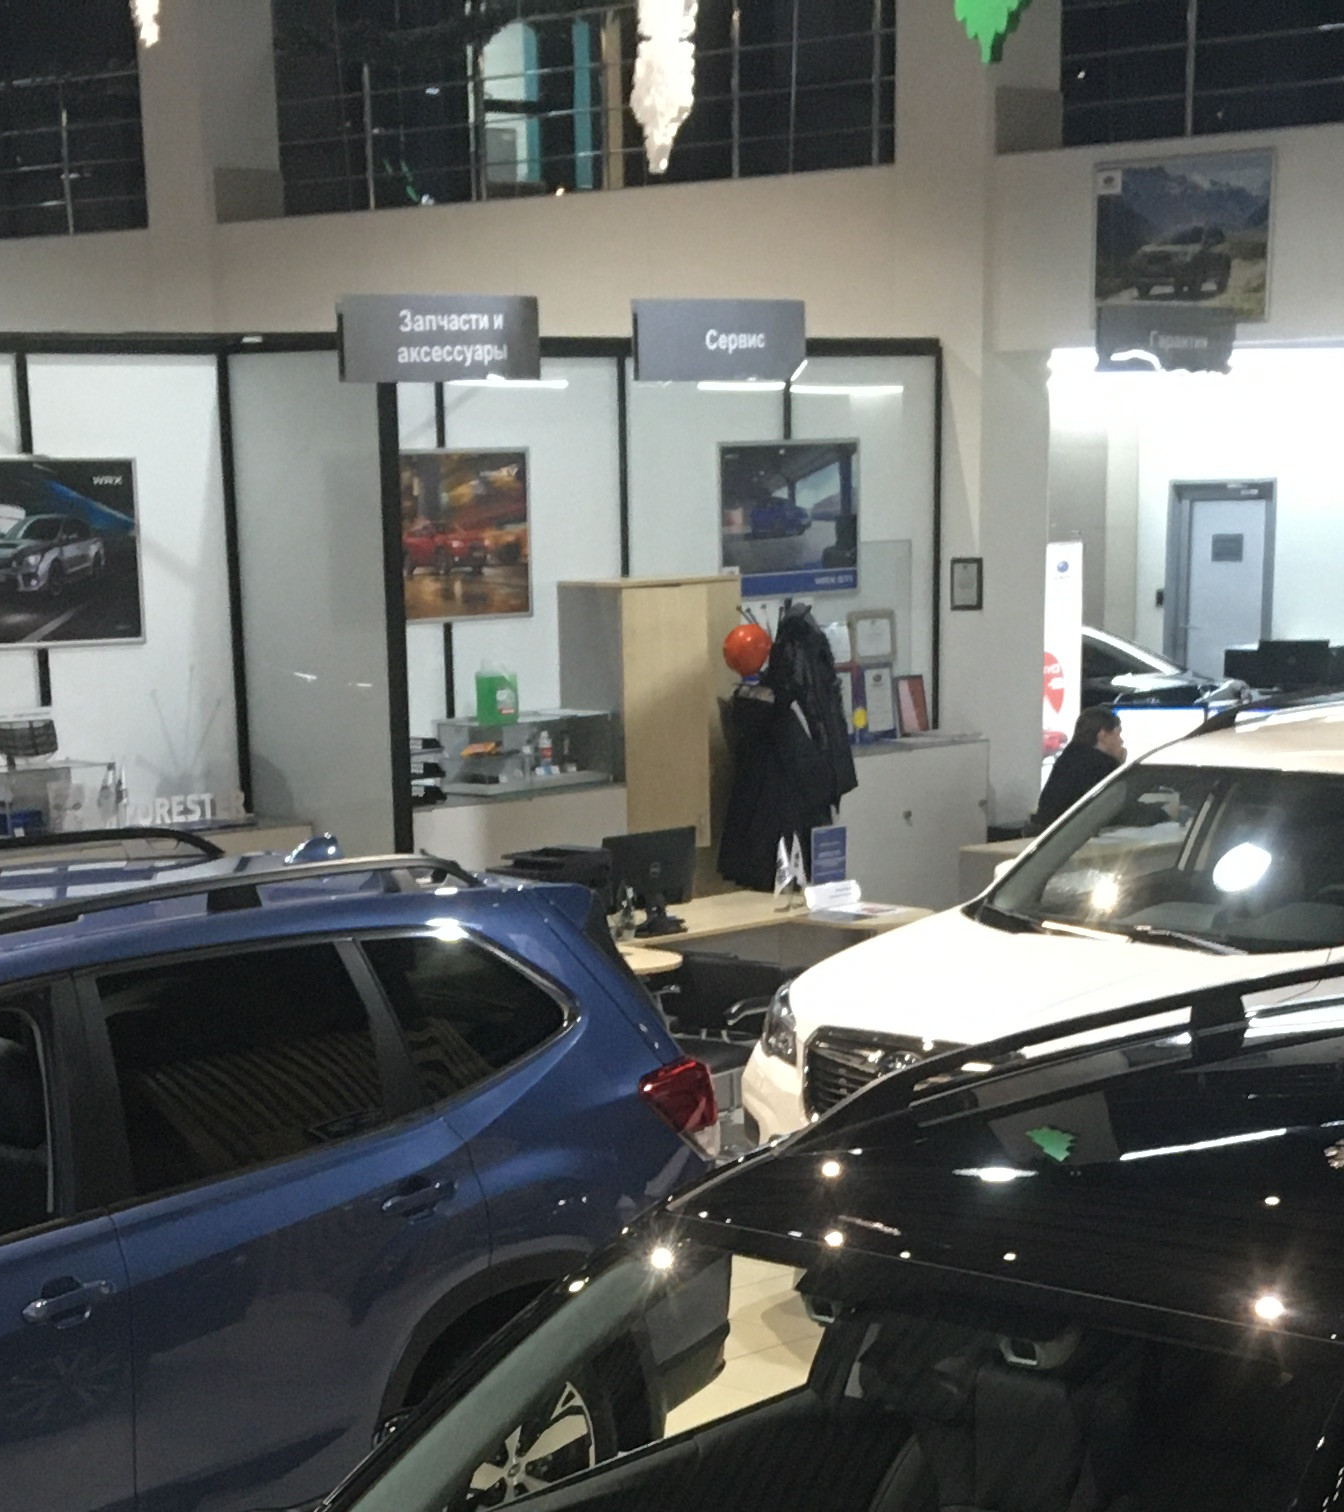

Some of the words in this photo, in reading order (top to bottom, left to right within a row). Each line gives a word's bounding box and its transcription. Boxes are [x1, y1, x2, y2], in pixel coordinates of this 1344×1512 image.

[399, 308, 490, 332] Запчасти
[493, 313, 505, 330] и
[705, 328, 765, 355] Сервис
[397, 343, 508, 367] аксессуары
